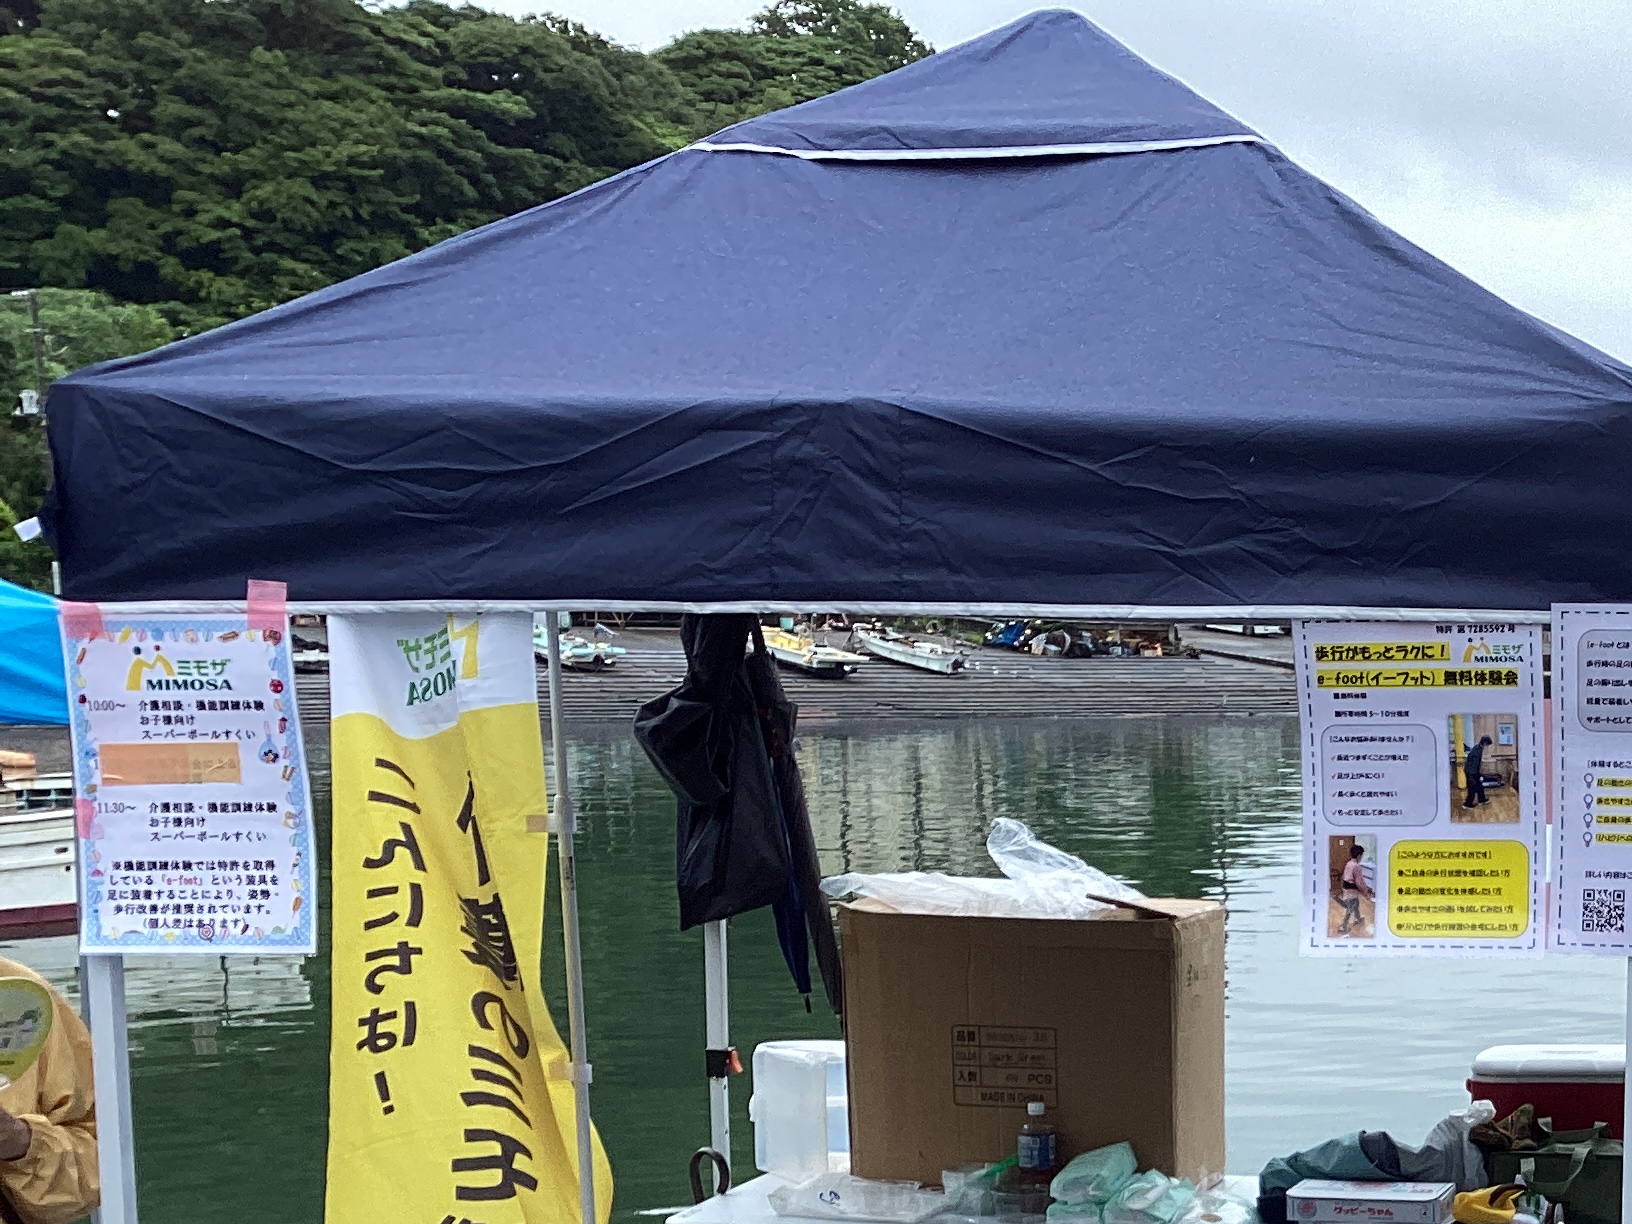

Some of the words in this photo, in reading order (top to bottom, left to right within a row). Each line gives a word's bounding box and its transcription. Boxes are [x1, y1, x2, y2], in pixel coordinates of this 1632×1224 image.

[1490, 643, 1524, 655] ミモザ
[1473, 655, 1524, 663] MIMOSA
[176, 657, 232, 677] ミモザ
[1444, 669, 1520, 686] 無料体験会
[146, 678, 233, 692] MIMOSA
[138, 699, 266, 713] 介護相談・機能訓練体験
[139, 714, 196, 727] お子様向け
[141, 728, 256, 741] スーパーボールすくい
[148, 801, 278, 814] 介護相談・機能訓練体験
[148, 816, 206, 828] お子様向け
[150, 831, 267, 843] スーパーボールすくい
[1027, 1073, 1053, 1084] PCS
[980, 1091, 1005, 1102] MADE
[1007, 1092, 1016, 1102] IN
